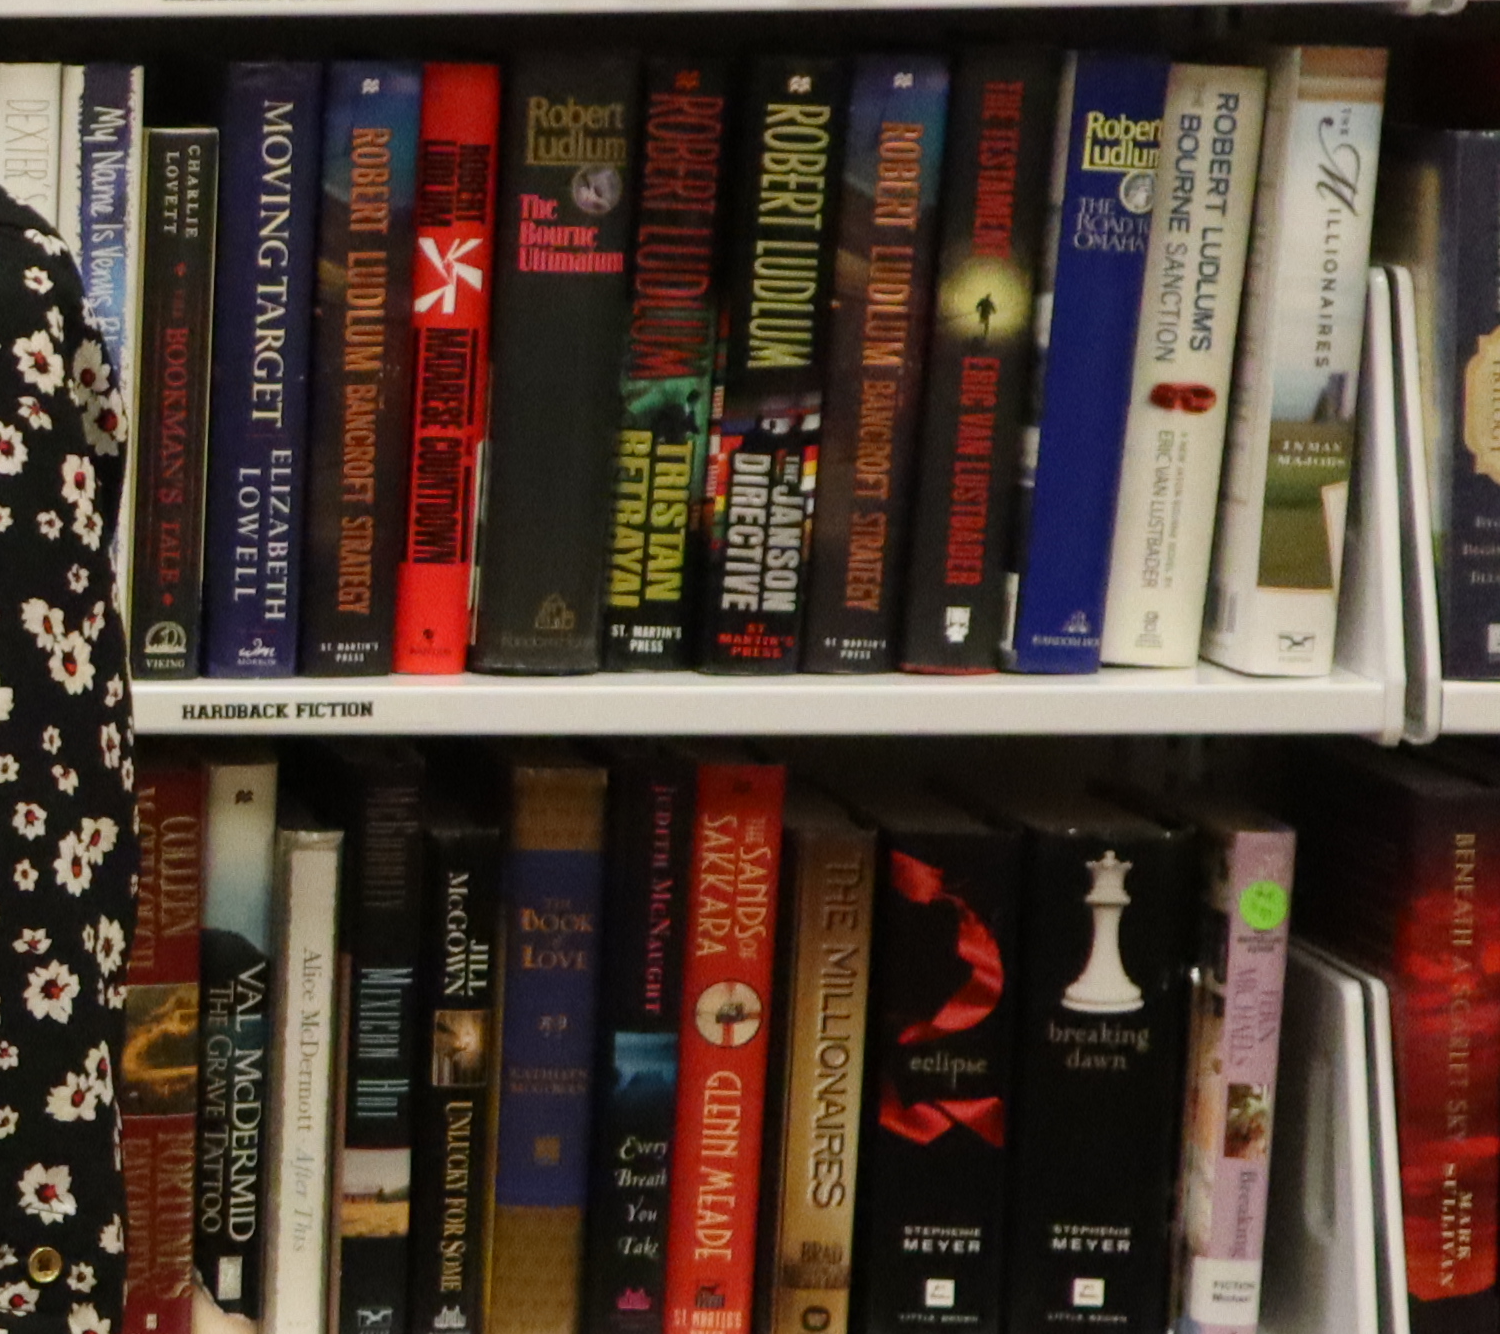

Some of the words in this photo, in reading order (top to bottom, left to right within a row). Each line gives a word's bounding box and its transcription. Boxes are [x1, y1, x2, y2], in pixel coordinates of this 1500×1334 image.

[258, 99, 295, 263] MOVING
[758, 103, 832, 232] ROBERT
[251, 275, 290, 428] TARGET
[747, 239, 820, 370] LUDLUM
[145, 656, 186, 670] VIKING
